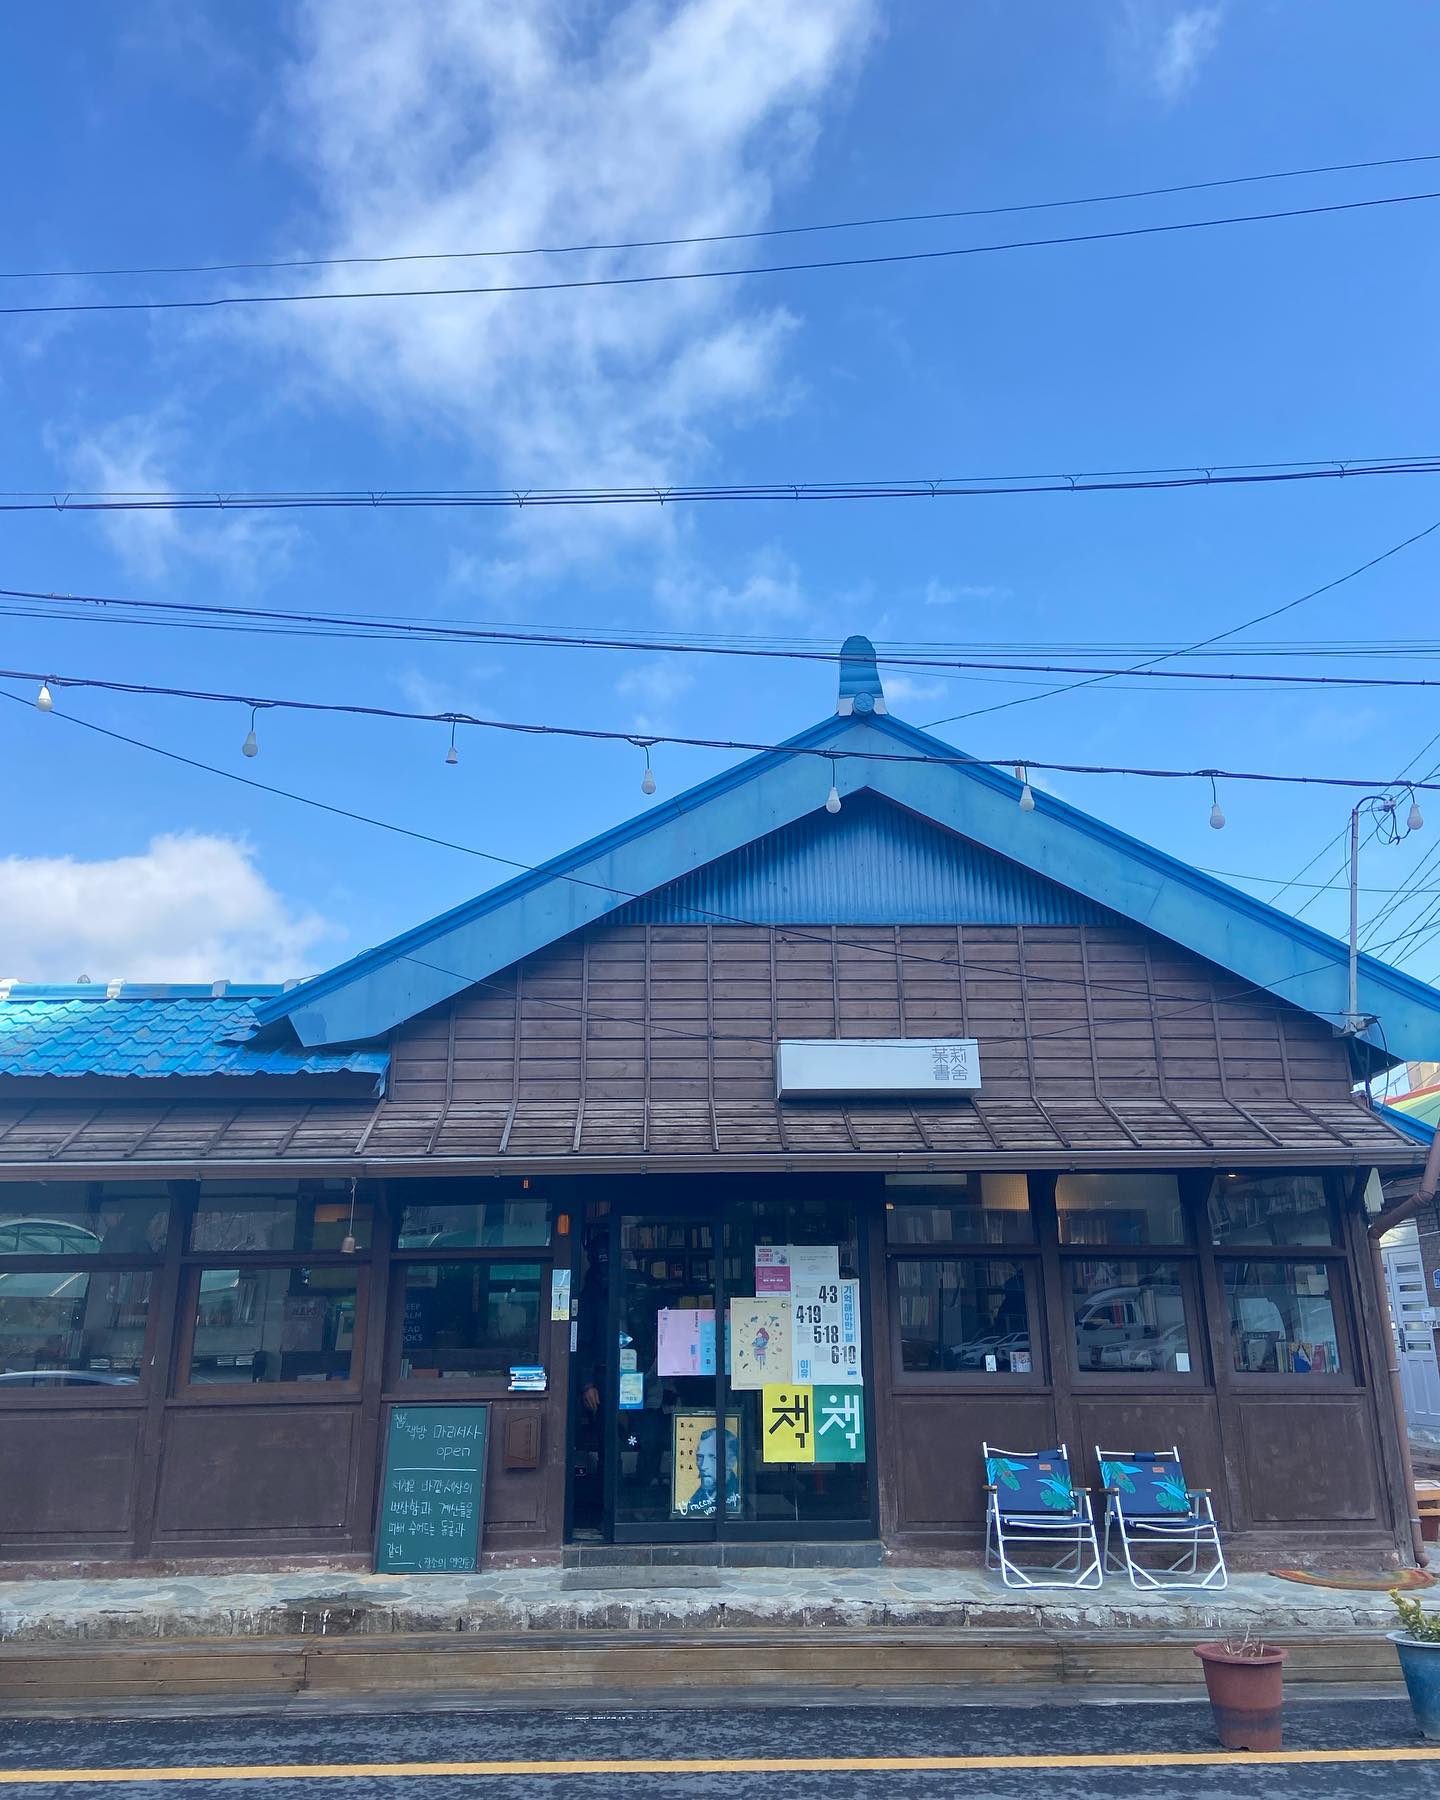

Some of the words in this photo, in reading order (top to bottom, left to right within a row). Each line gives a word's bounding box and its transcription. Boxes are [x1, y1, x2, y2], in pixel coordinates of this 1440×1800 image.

[843, 1285, 854, 1331] 기억해야만
[433, 1423, 483, 1440] 마리서사
[769, 1394, 811, 1449] 책
[818, 1394, 861, 1449] 책
[436, 1446, 471, 1462] open
